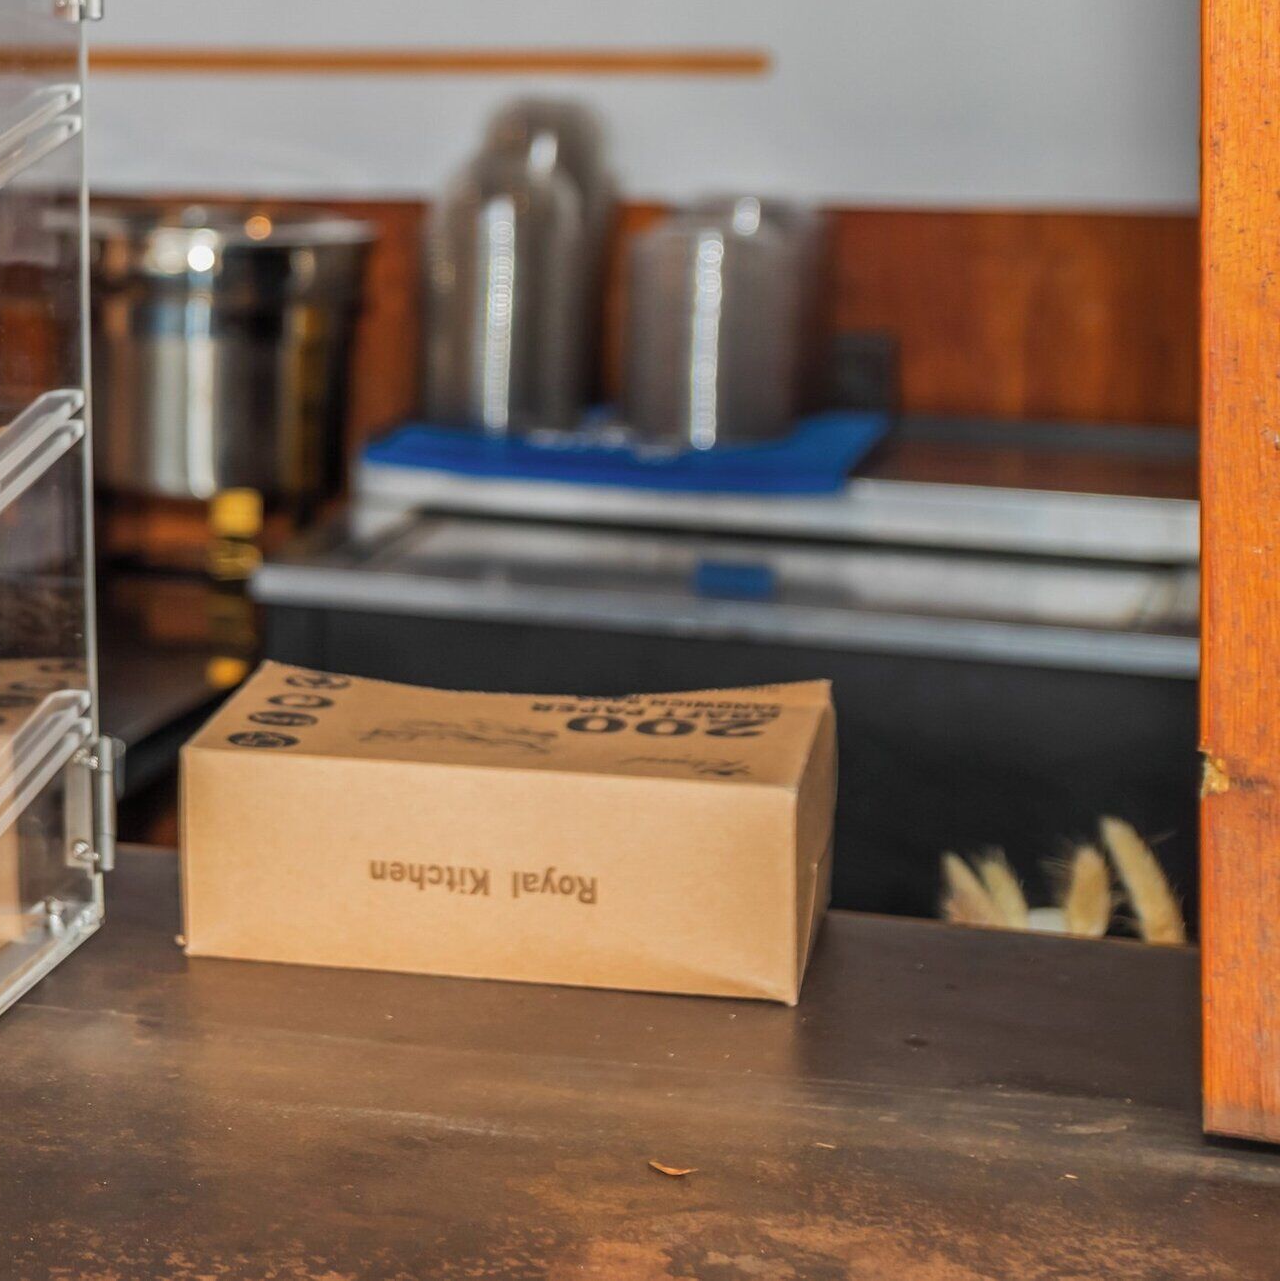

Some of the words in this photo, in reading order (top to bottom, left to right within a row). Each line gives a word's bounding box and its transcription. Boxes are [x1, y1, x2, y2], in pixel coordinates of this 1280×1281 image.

[531, 702, 645, 717] PAPER
[566, 715, 773, 738] 200
[368, 859, 490, 896] Kitchen
[511, 866, 598, 905] Royal
